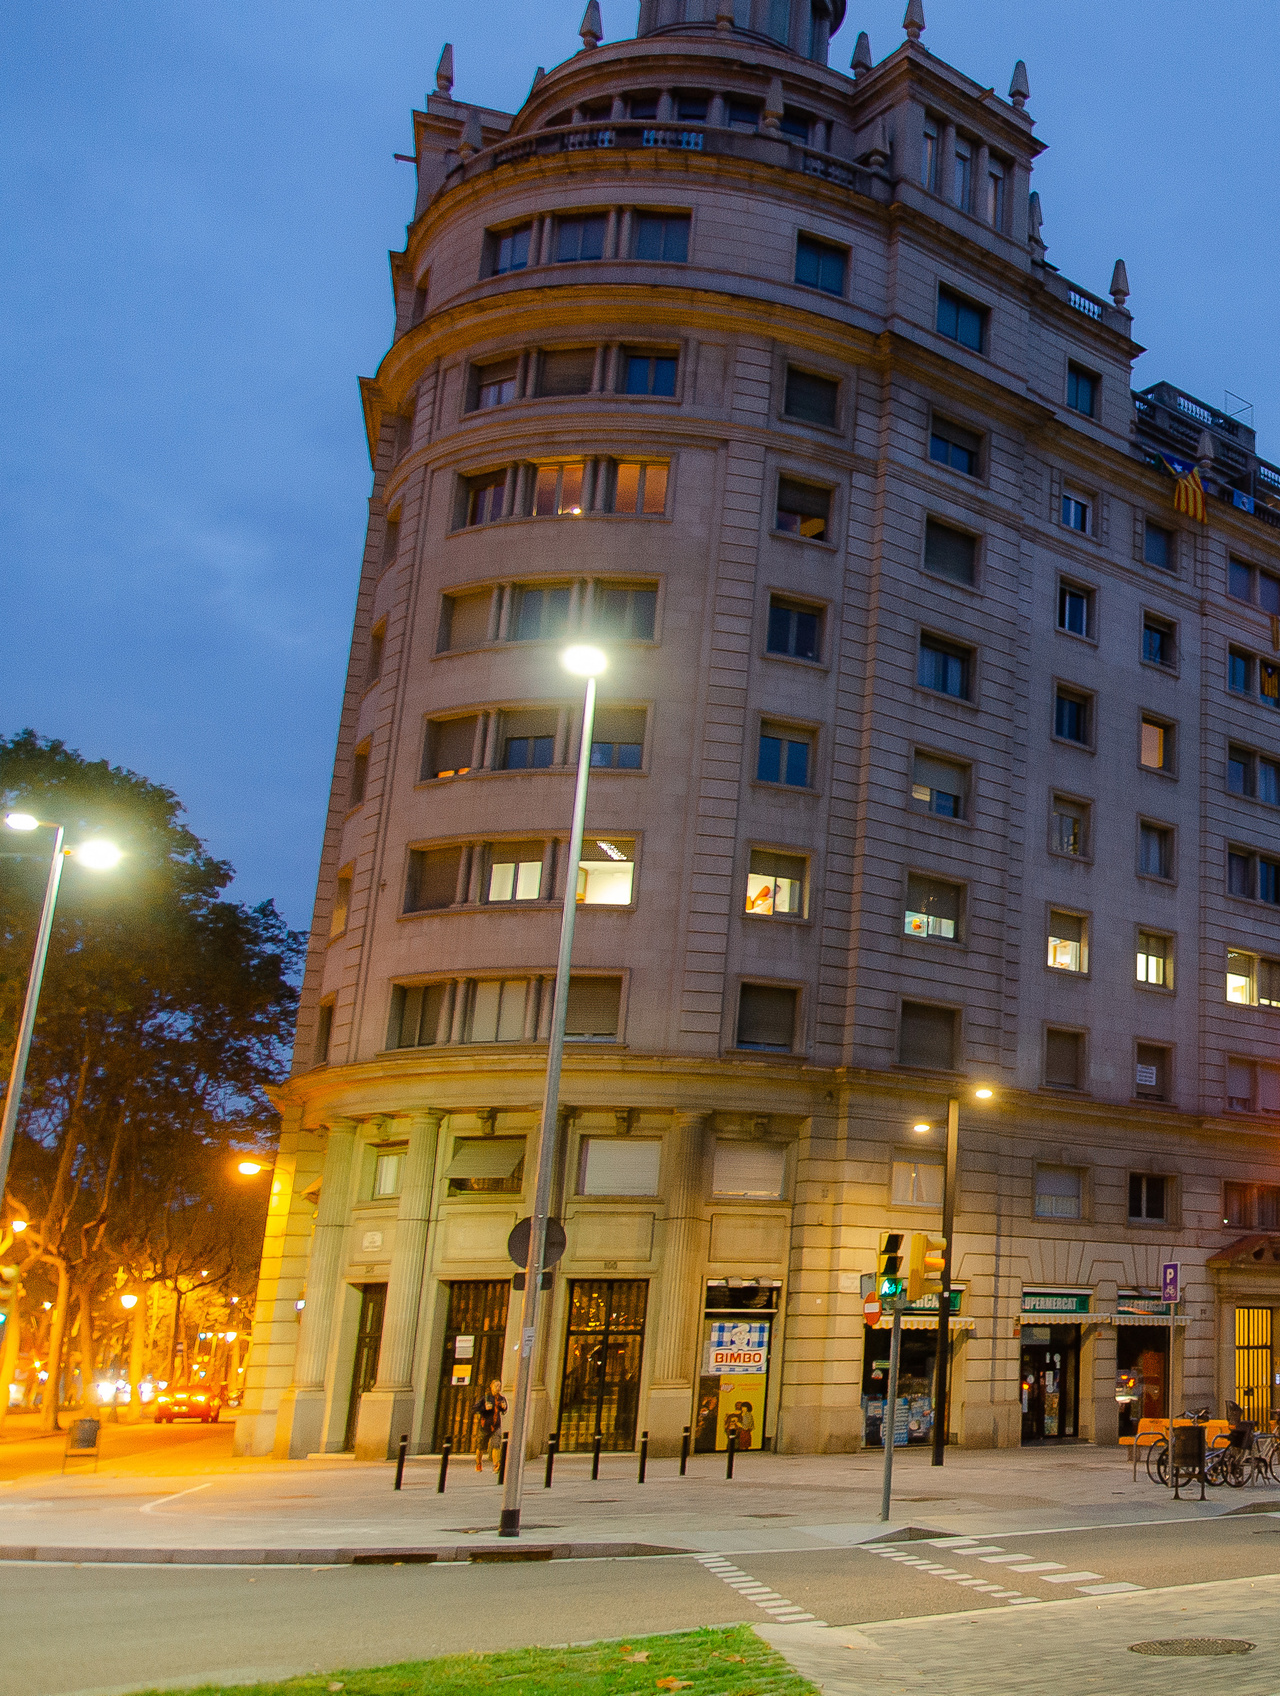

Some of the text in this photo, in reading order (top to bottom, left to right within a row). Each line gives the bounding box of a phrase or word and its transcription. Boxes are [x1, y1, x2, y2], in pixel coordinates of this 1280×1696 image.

[1166, 1268, 1175, 1283] P
[1023, 1297, 1077, 1310] UPERMERCAT
[714, 1352, 763, 1364] BIMBO
